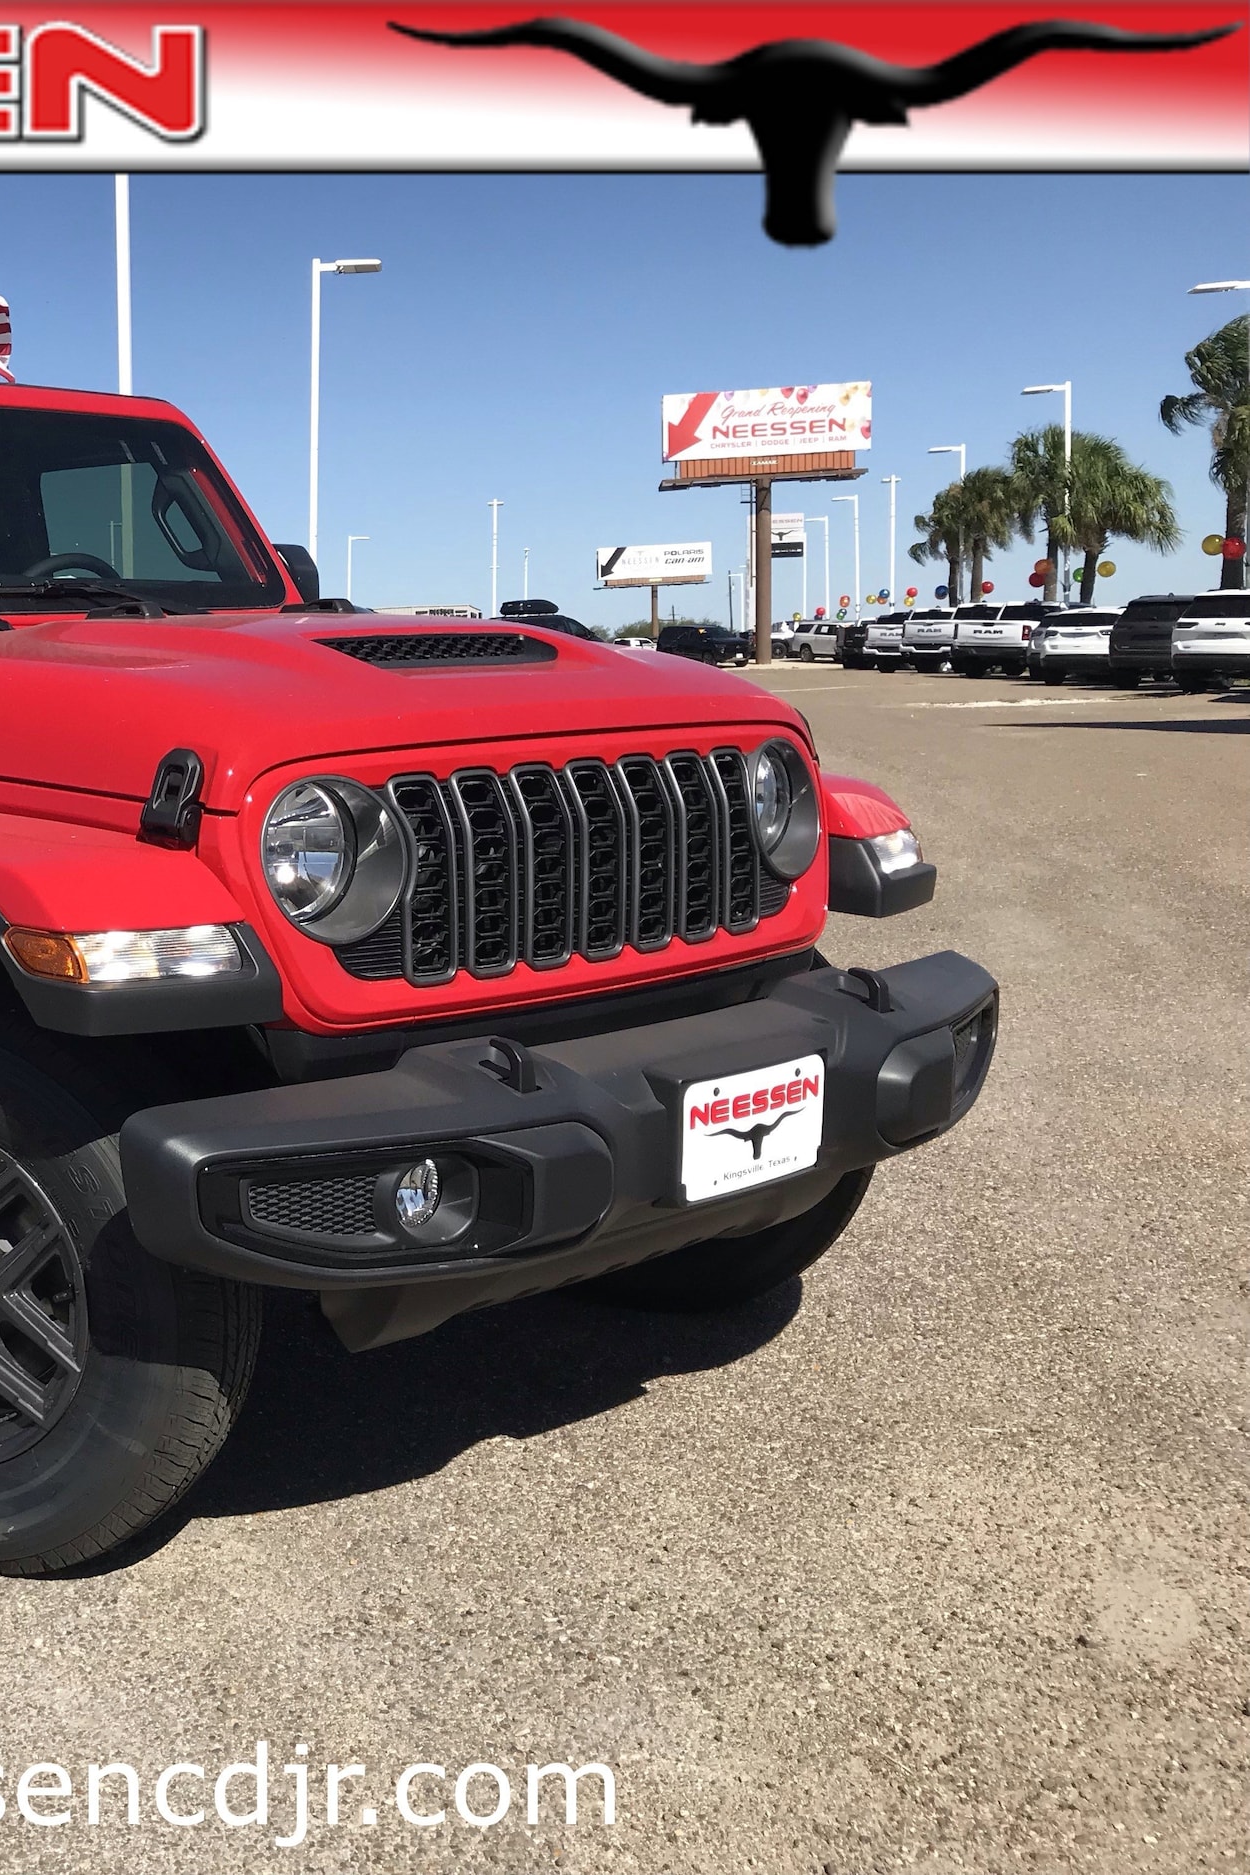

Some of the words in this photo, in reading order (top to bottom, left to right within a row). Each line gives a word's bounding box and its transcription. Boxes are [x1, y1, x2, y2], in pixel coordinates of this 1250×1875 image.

[721, 400, 766, 426] Grand
[767, 401, 836, 419] Reopening
[712, 417, 847, 440] NEESSEN
[710, 441, 752, 449] CHRYSLER
[690, 1074, 819, 1130] NEESSEN
[768, 1156, 791, 1168] Texas
